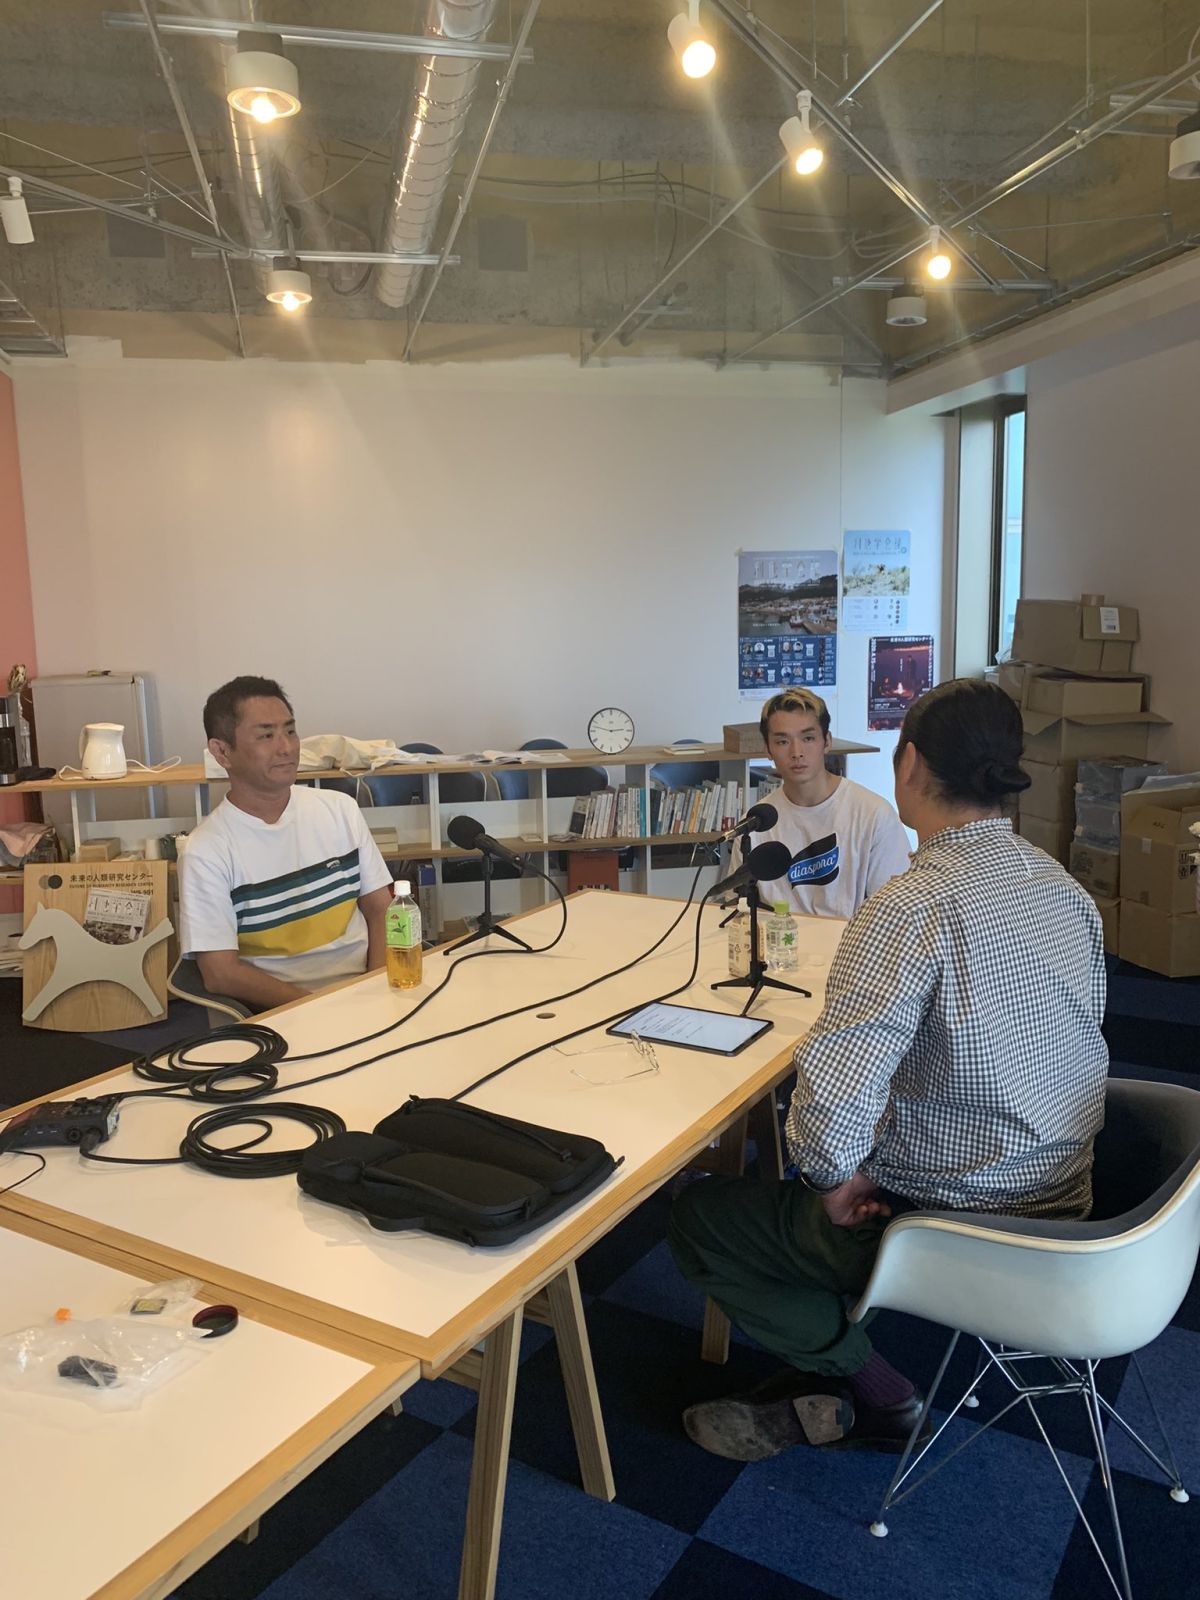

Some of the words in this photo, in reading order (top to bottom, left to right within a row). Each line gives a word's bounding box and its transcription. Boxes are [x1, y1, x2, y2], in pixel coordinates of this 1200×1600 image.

[70, 873, 153, 882] 未来の人類研究センター
